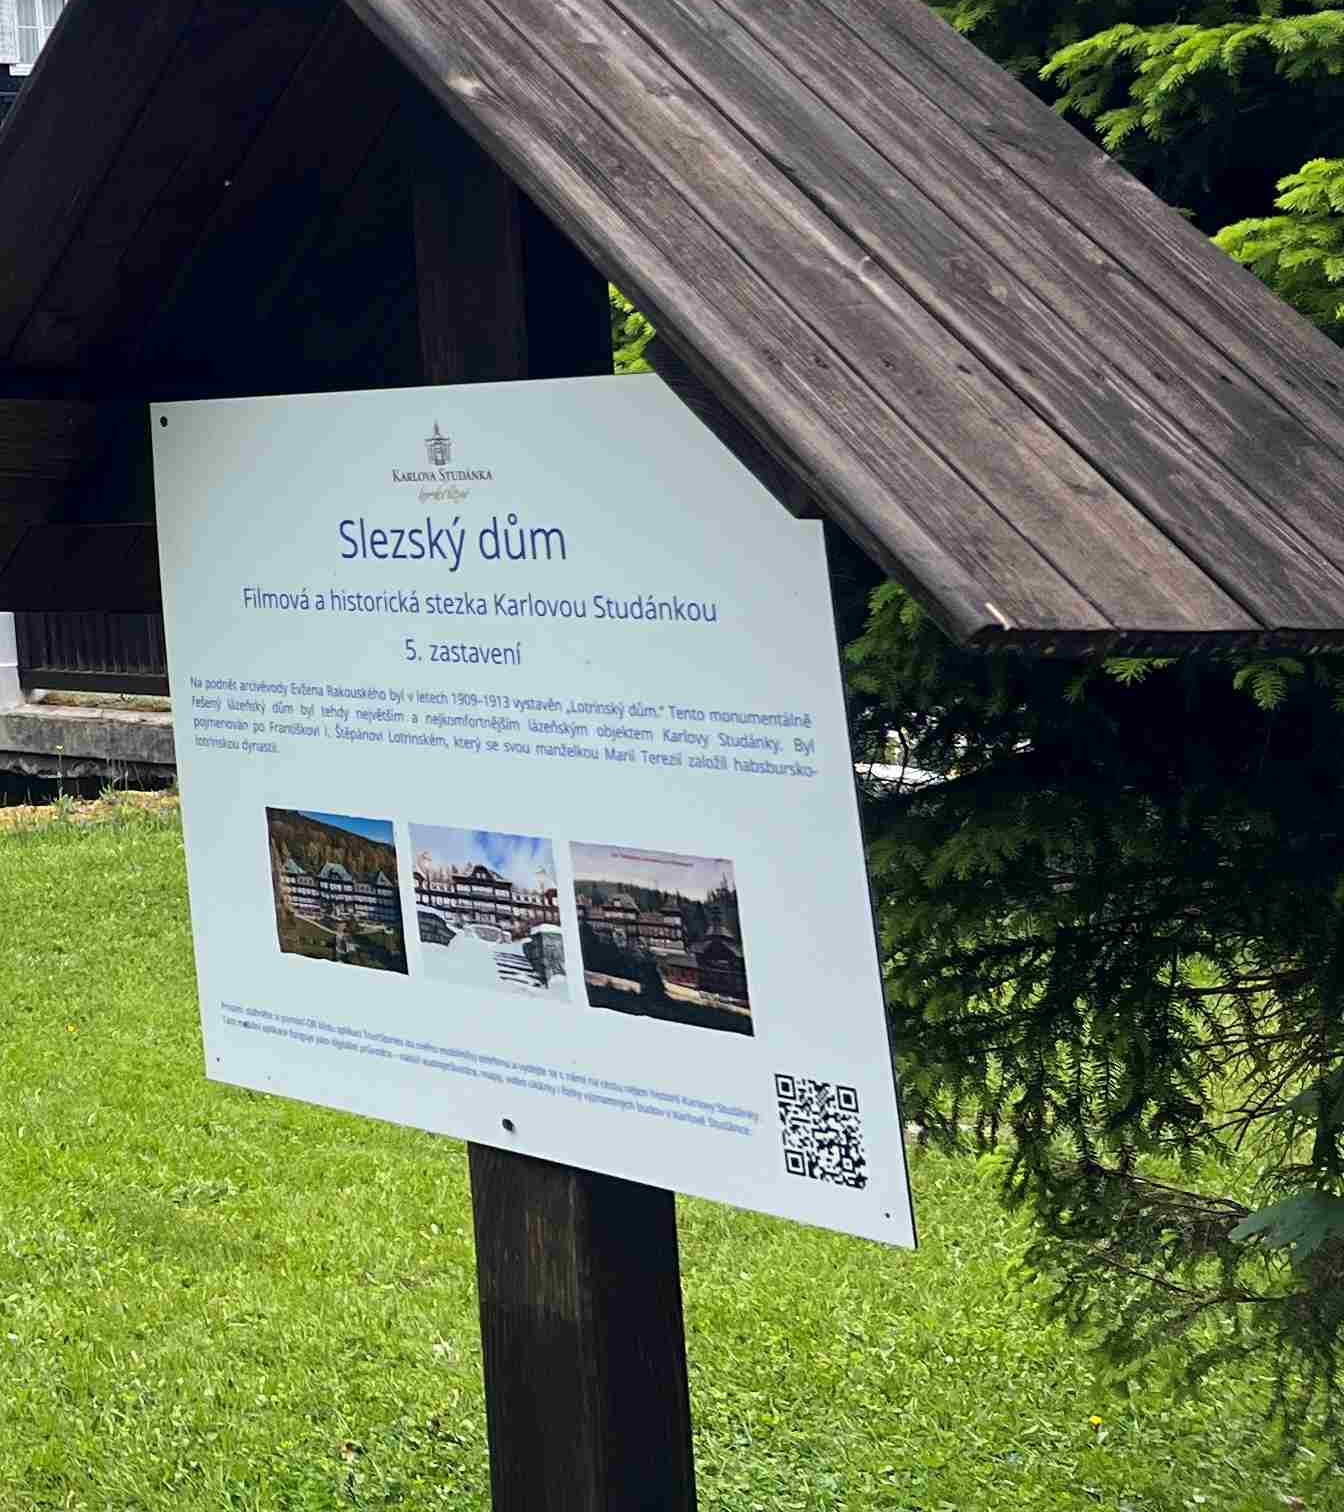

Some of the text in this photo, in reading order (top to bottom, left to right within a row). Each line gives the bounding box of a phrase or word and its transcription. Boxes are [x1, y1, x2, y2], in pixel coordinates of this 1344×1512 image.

[339, 513, 567, 572] Slezský dům
[243, 587, 718, 622] Filmová a historická stezka Karlovou Studánkou
[405, 639, 522, 665] 5. zastavení
[190, 676, 203, 689] Na
[326, 685, 387, 701] Rakouského
[416, 690, 448, 705] letech
[668, 704, 705, 721] Tento
[709, 709, 812, 729] monumentálně
[454, 735, 481, 752] který
[485, 739, 500, 751] se
[503, 741, 530, 754] svou
[535, 740, 600, 760] manželkou
[596, 724, 654, 742] objektem
[662, 728, 711, 749] Karlovy
[717, 732, 784, 755] Studánky.
[793, 737, 816, 756] Byl
